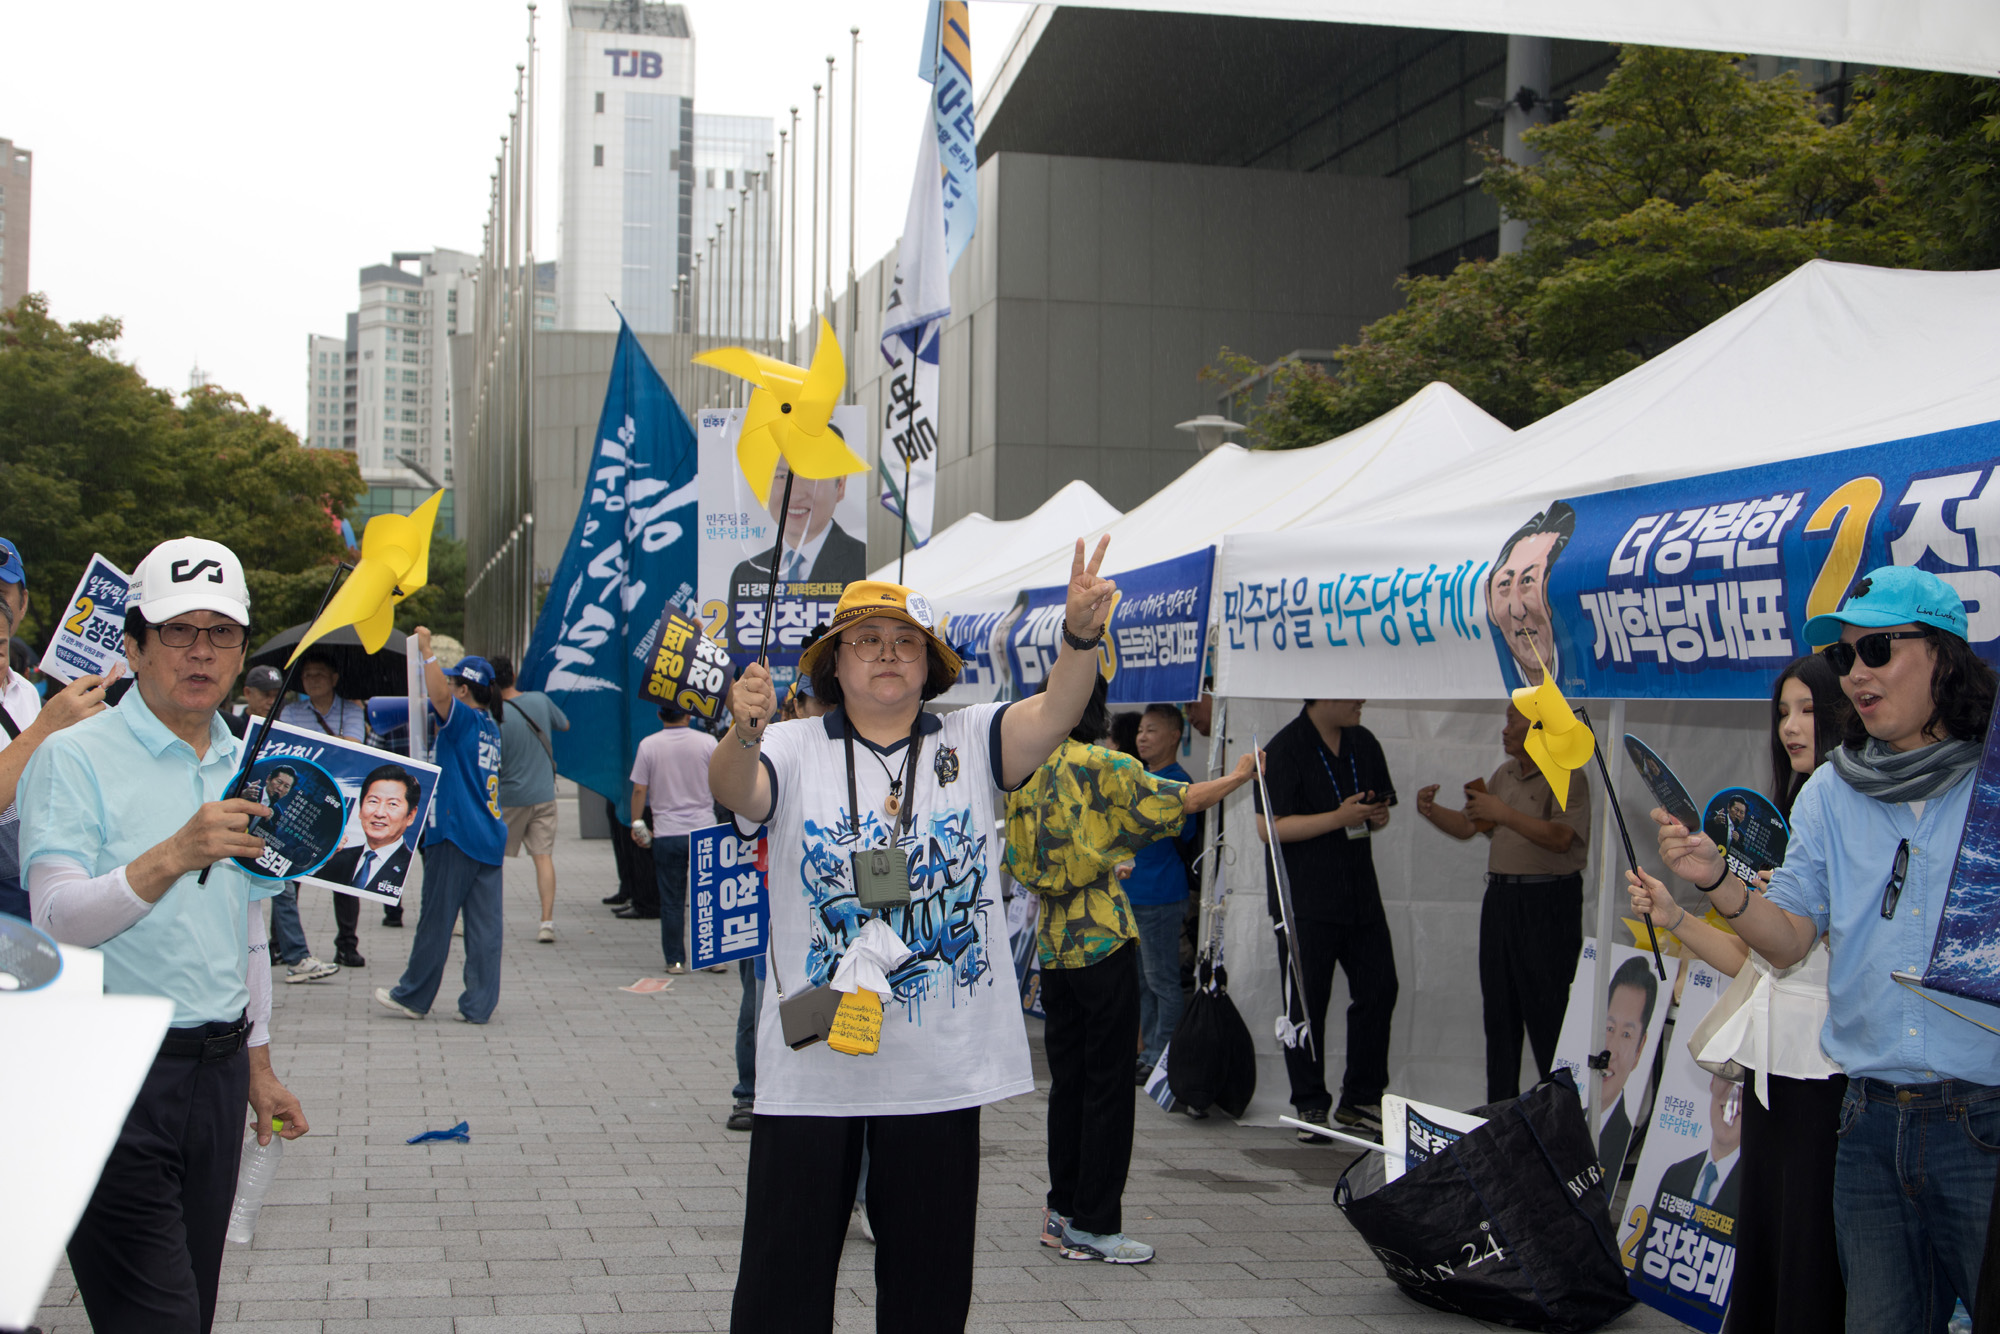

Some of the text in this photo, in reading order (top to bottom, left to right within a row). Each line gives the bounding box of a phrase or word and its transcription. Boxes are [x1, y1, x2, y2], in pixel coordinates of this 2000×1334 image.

[603, 48, 662, 79] TJB
[1803, 477, 1883, 653] 2
[87, 576, 127, 606] 알정찍!
[738, 582, 843, 596] 더 강력한 개혁당대표
[1140, 592, 1165, 619] 이기는
[1166, 586, 1198, 617] 민주당
[1223, 560, 1489, 651] 민주당을 민주당답게!
[64, 597, 94, 637] 2
[702, 600, 729, 648] 2
[1580, 579, 1793, 663] 개혁당대표
[1935, 608, 1956, 624] Lucky
[648, 614, 696, 701] 알정찍!
[677, 688, 720, 718] 2
[486, 774, 501, 820] 3
[254, 846, 293, 878] 청래
[697, 837, 714, 961] 반드시 승리하자!
[720, 835, 759, 954] 정청래
[1583, 947, 1597, 960] 민주
[1693, 974, 1713, 988] 민주당
[1659, 1113, 1702, 1138] 민주당답게!
[1664, 1095, 1695, 1118] 민주당을
[1567, 1161, 1601, 1199] BUB
[1659, 1192, 1735, 1235] 더 강력한 개혁당대표
[1621, 1205, 1735, 1306] 2 정청래
